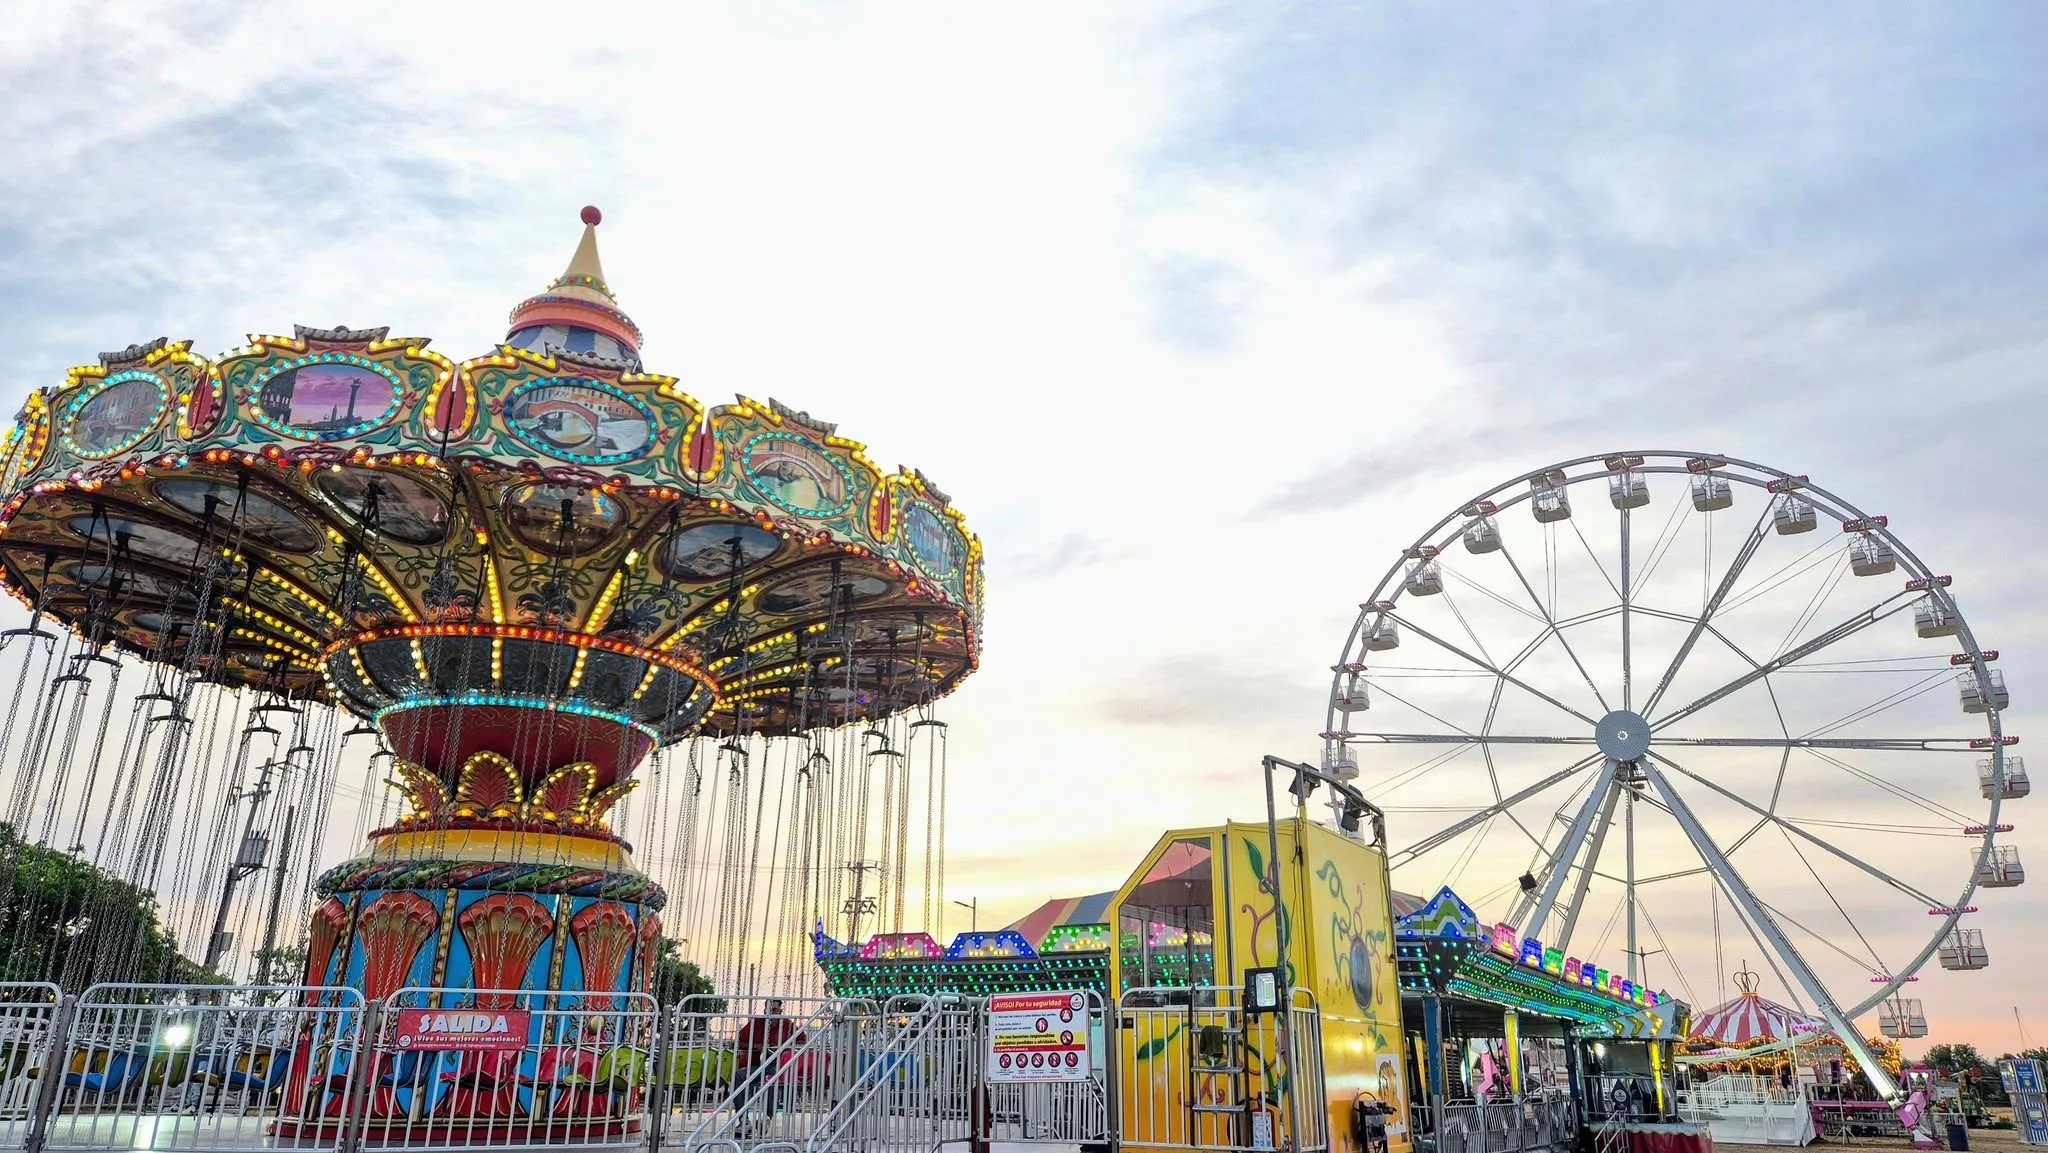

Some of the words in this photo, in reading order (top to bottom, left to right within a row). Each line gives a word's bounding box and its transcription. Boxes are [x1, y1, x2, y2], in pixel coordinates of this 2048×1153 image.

[994, 1001, 1015, 1010] ¡AVISO!
[1033, 999, 1062, 1008] seguridad
[418, 1014, 509, 1033] SALIDA
